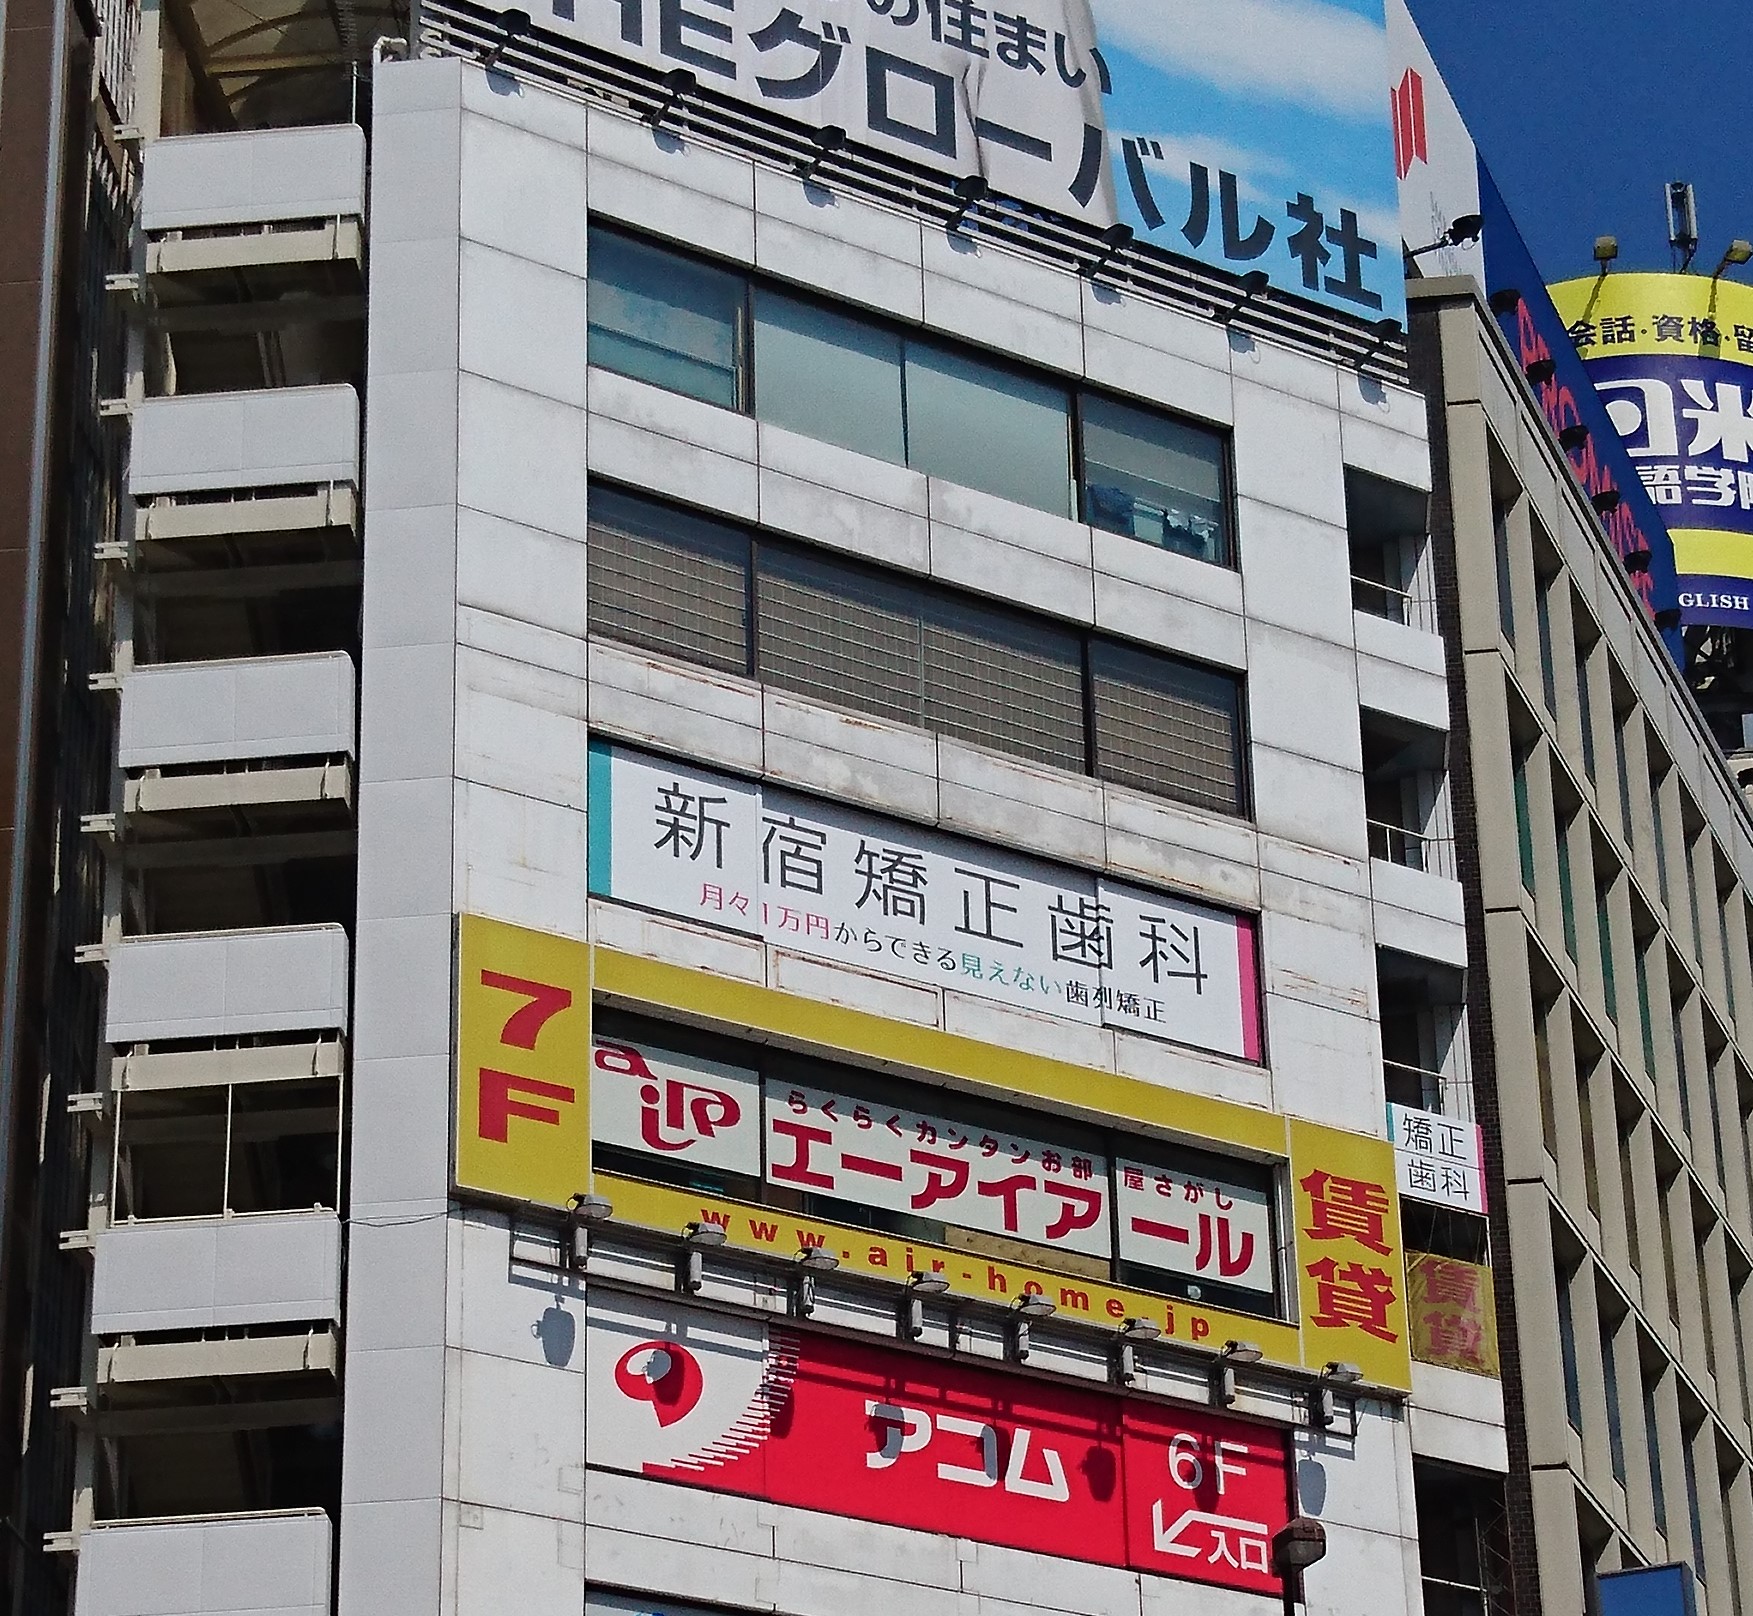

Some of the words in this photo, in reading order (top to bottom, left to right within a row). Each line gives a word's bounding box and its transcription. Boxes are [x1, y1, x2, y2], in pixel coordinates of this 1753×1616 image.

[653, 781, 1208, 995] 新宿矯正歯科
[478, 968, 575, 1143] 7F
[1402, 1112, 1467, 1160] 矯正
[1407, 1158, 1470, 1201] 歯科
[771, 1118, 1255, 1278] エーアイアール
[1301, 1168, 1399, 1344] 賃貸
[701, 1207, 1211, 1341] www.air-homejp
[864, 1398, 1070, 1502] アコム
[1168, 1433, 1249, 1495] 6F
[1207, 1526, 1269, 1576] 入口
